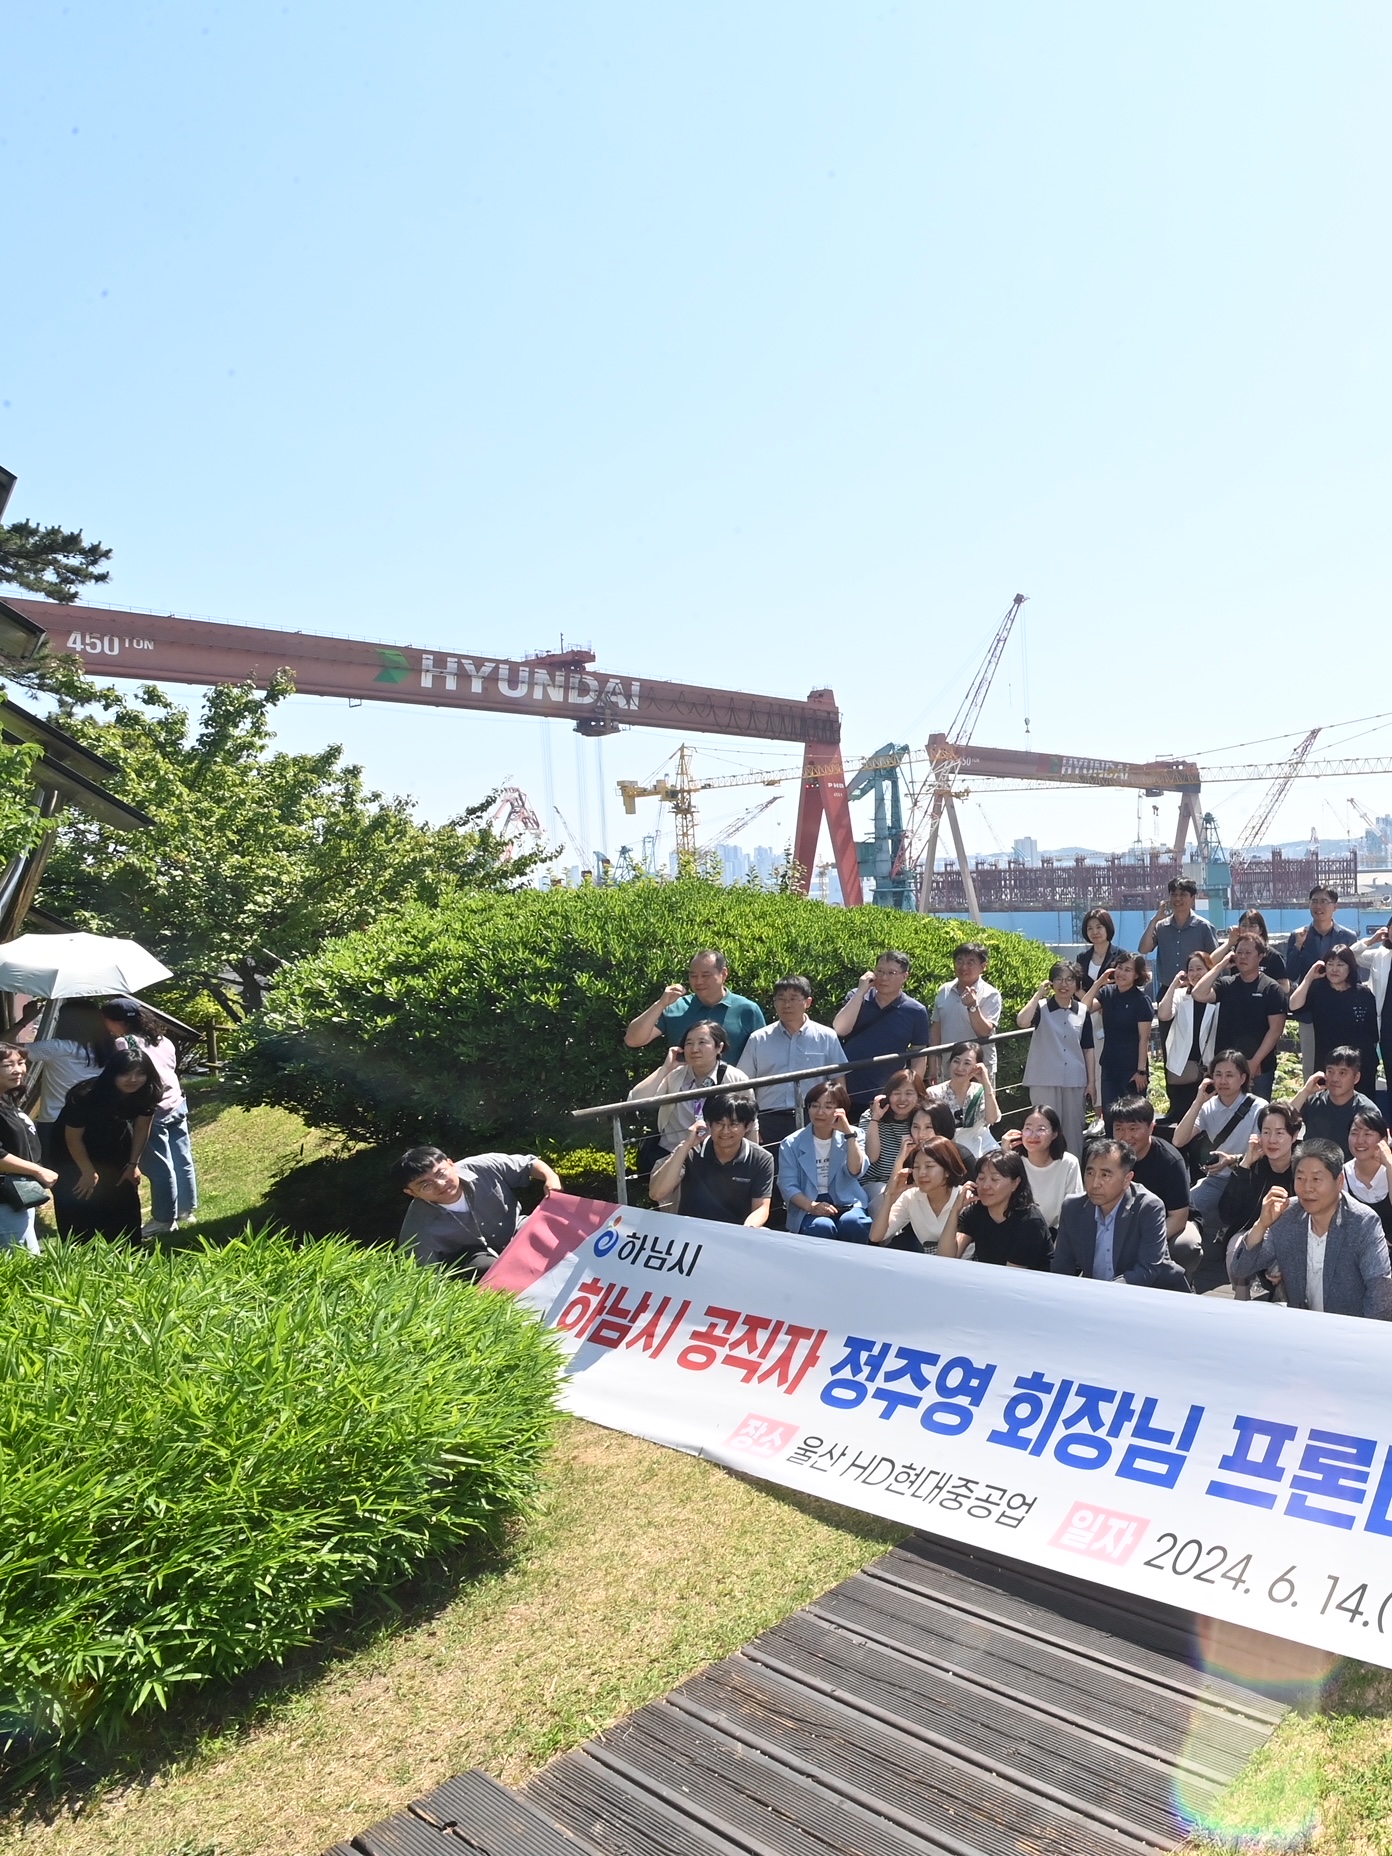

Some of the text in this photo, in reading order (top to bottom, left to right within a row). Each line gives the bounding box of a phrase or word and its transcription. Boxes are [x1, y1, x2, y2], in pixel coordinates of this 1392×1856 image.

[66, 631, 154, 656] 450 TON
[421, 654, 641, 710] HYUNDAI
[617, 1232, 703, 1277] 하남시
[557, 1277, 692, 1360] 하남시
[676, 1305, 828, 1395] 공직자
[819, 1335, 998, 1436] 정주영
[986, 1371, 1206, 1490] 회장님
[730, 1419, 784, 1456] 장소
[786, 1436, 1038, 1529] 울산 HD현대중공업
[1062, 1509, 1139, 1561] 일자
[1144, 1532, 1252, 1595] 2024.
[1267, 1566, 1298, 1608] 6.
